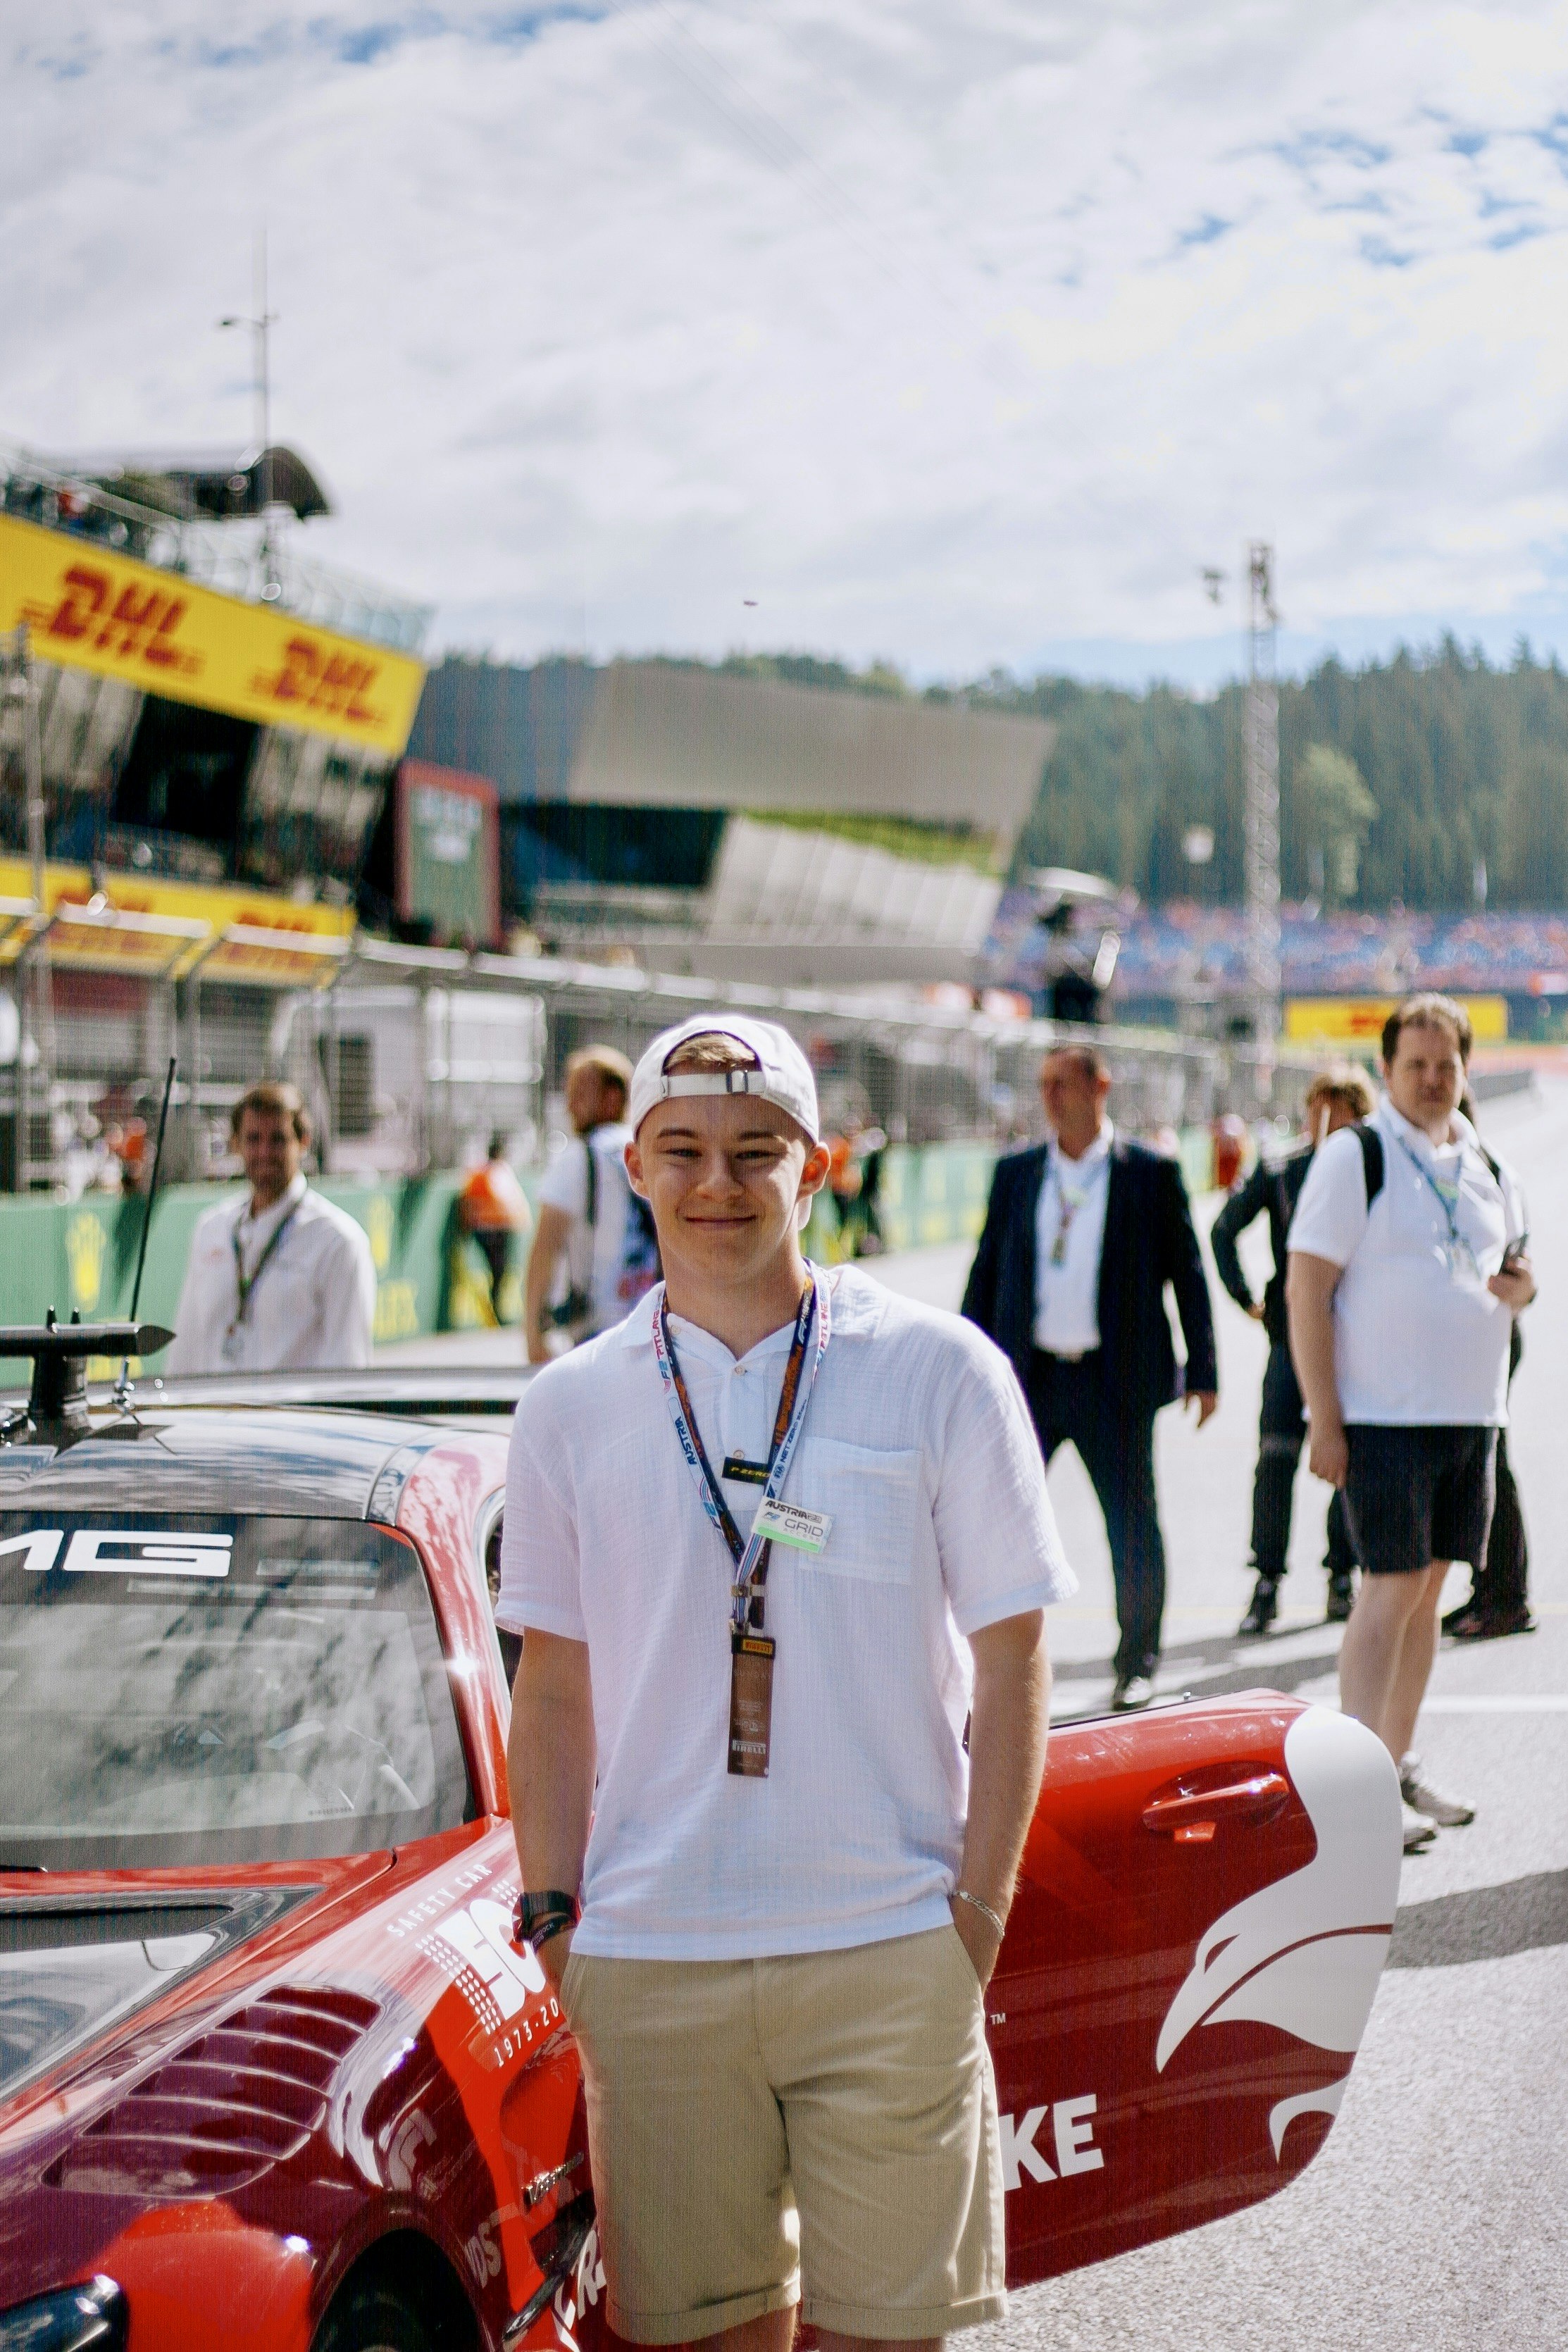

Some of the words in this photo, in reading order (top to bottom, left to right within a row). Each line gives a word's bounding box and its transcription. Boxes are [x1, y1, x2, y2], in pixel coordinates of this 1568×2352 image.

[44, 564, 190, 671] DHL
[674, 1416, 697, 1465] AUSTRIA
[785, 1519, 823, 1537] GRID
[387, 1887, 456, 1939] SAFETY
[454, 1863, 493, 1889] CAR
[990, 2012, 1007, 2025] TM
